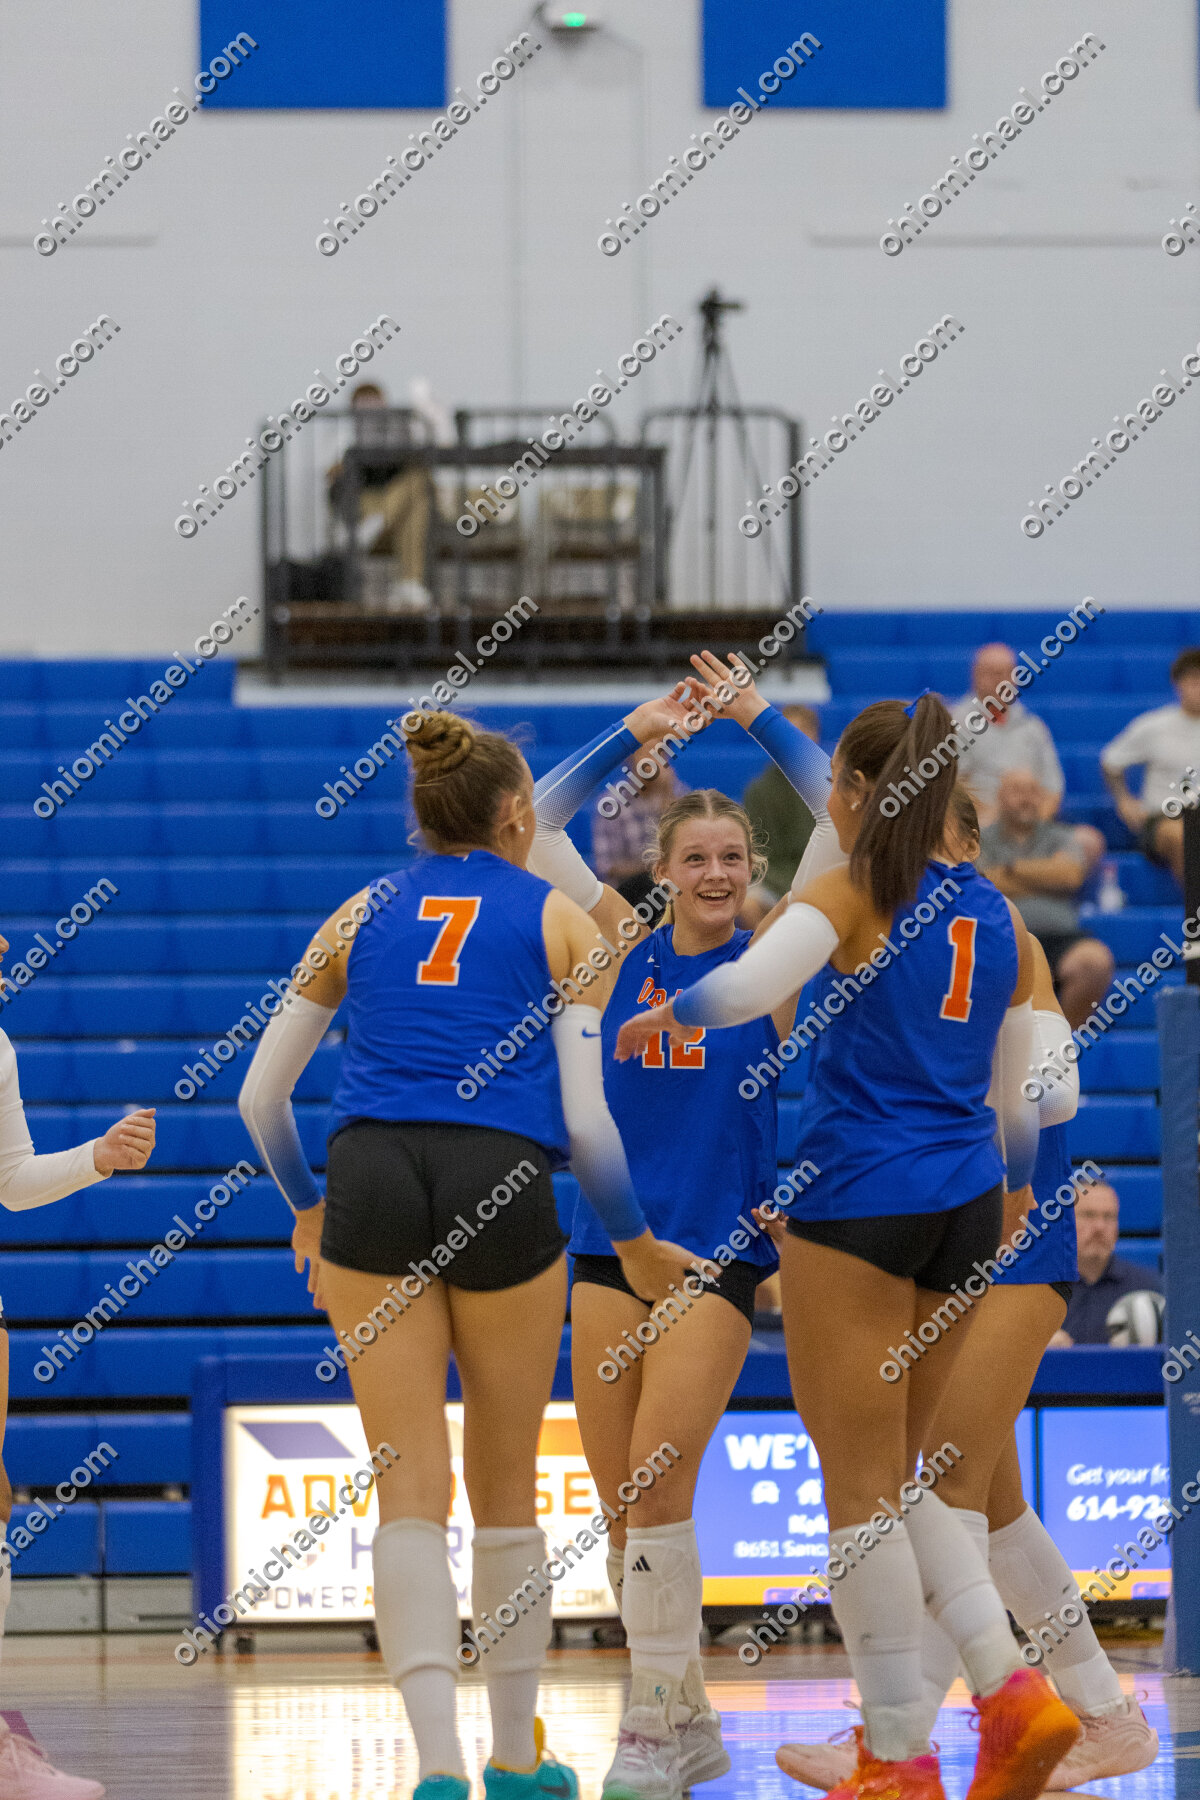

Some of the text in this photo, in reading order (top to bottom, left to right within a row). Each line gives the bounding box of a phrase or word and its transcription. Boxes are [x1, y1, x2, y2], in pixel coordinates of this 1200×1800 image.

[416, 895, 482, 986] 7
[939, 916, 977, 1023] 1
[642, 1027, 706, 1069] 12
[260, 1471, 596, 1519] ADVSE
[1066, 1494, 1170, 1522] 614-92
